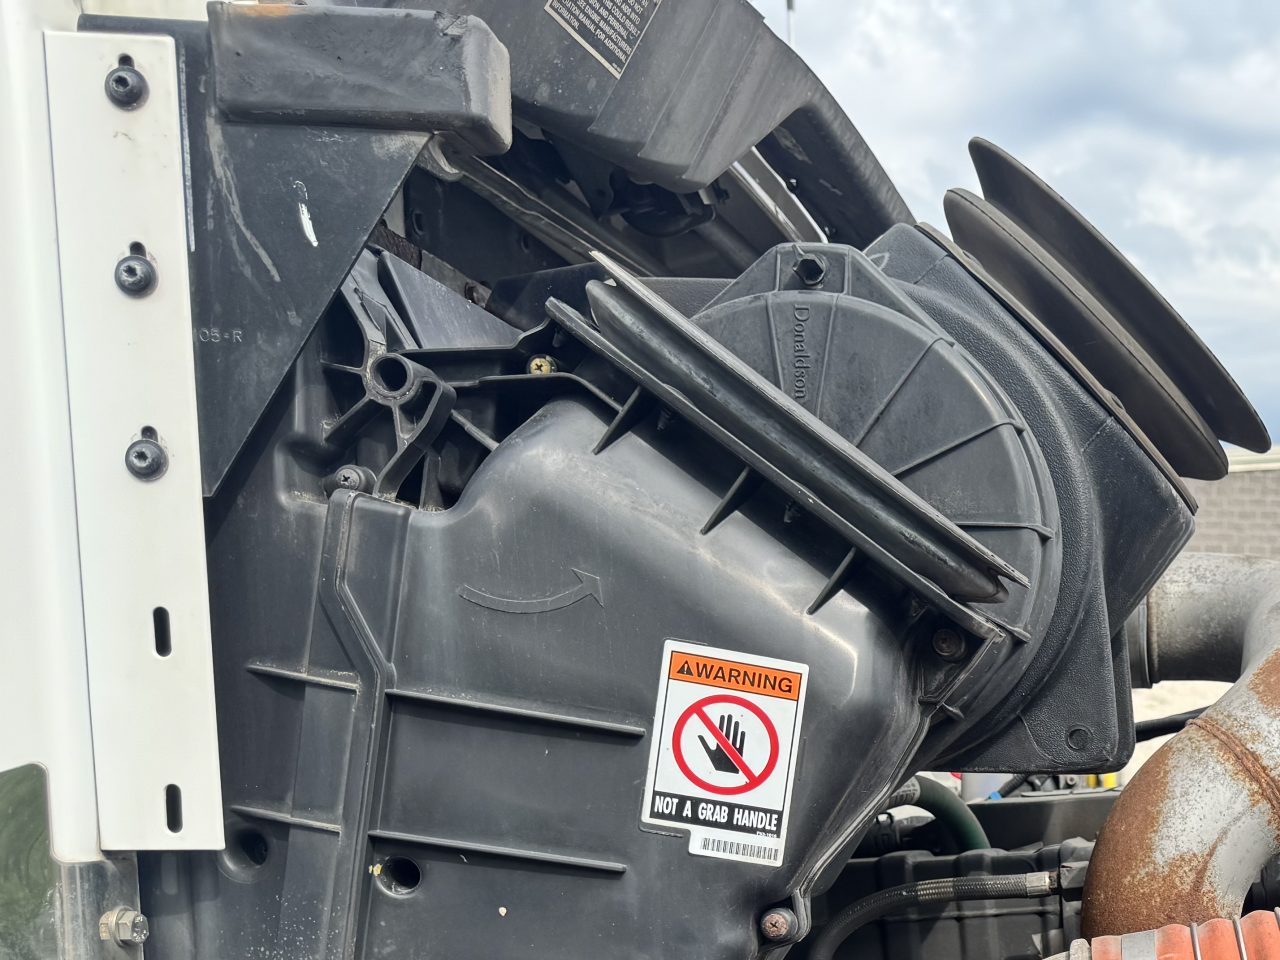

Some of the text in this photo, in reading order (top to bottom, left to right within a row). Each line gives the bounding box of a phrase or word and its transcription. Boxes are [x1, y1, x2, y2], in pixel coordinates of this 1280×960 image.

[794, 304, 811, 400] Donaldson
[695, 661, 793, 694] WARNING
[654, 795, 778, 831] NOT A GRAB HANDLE
